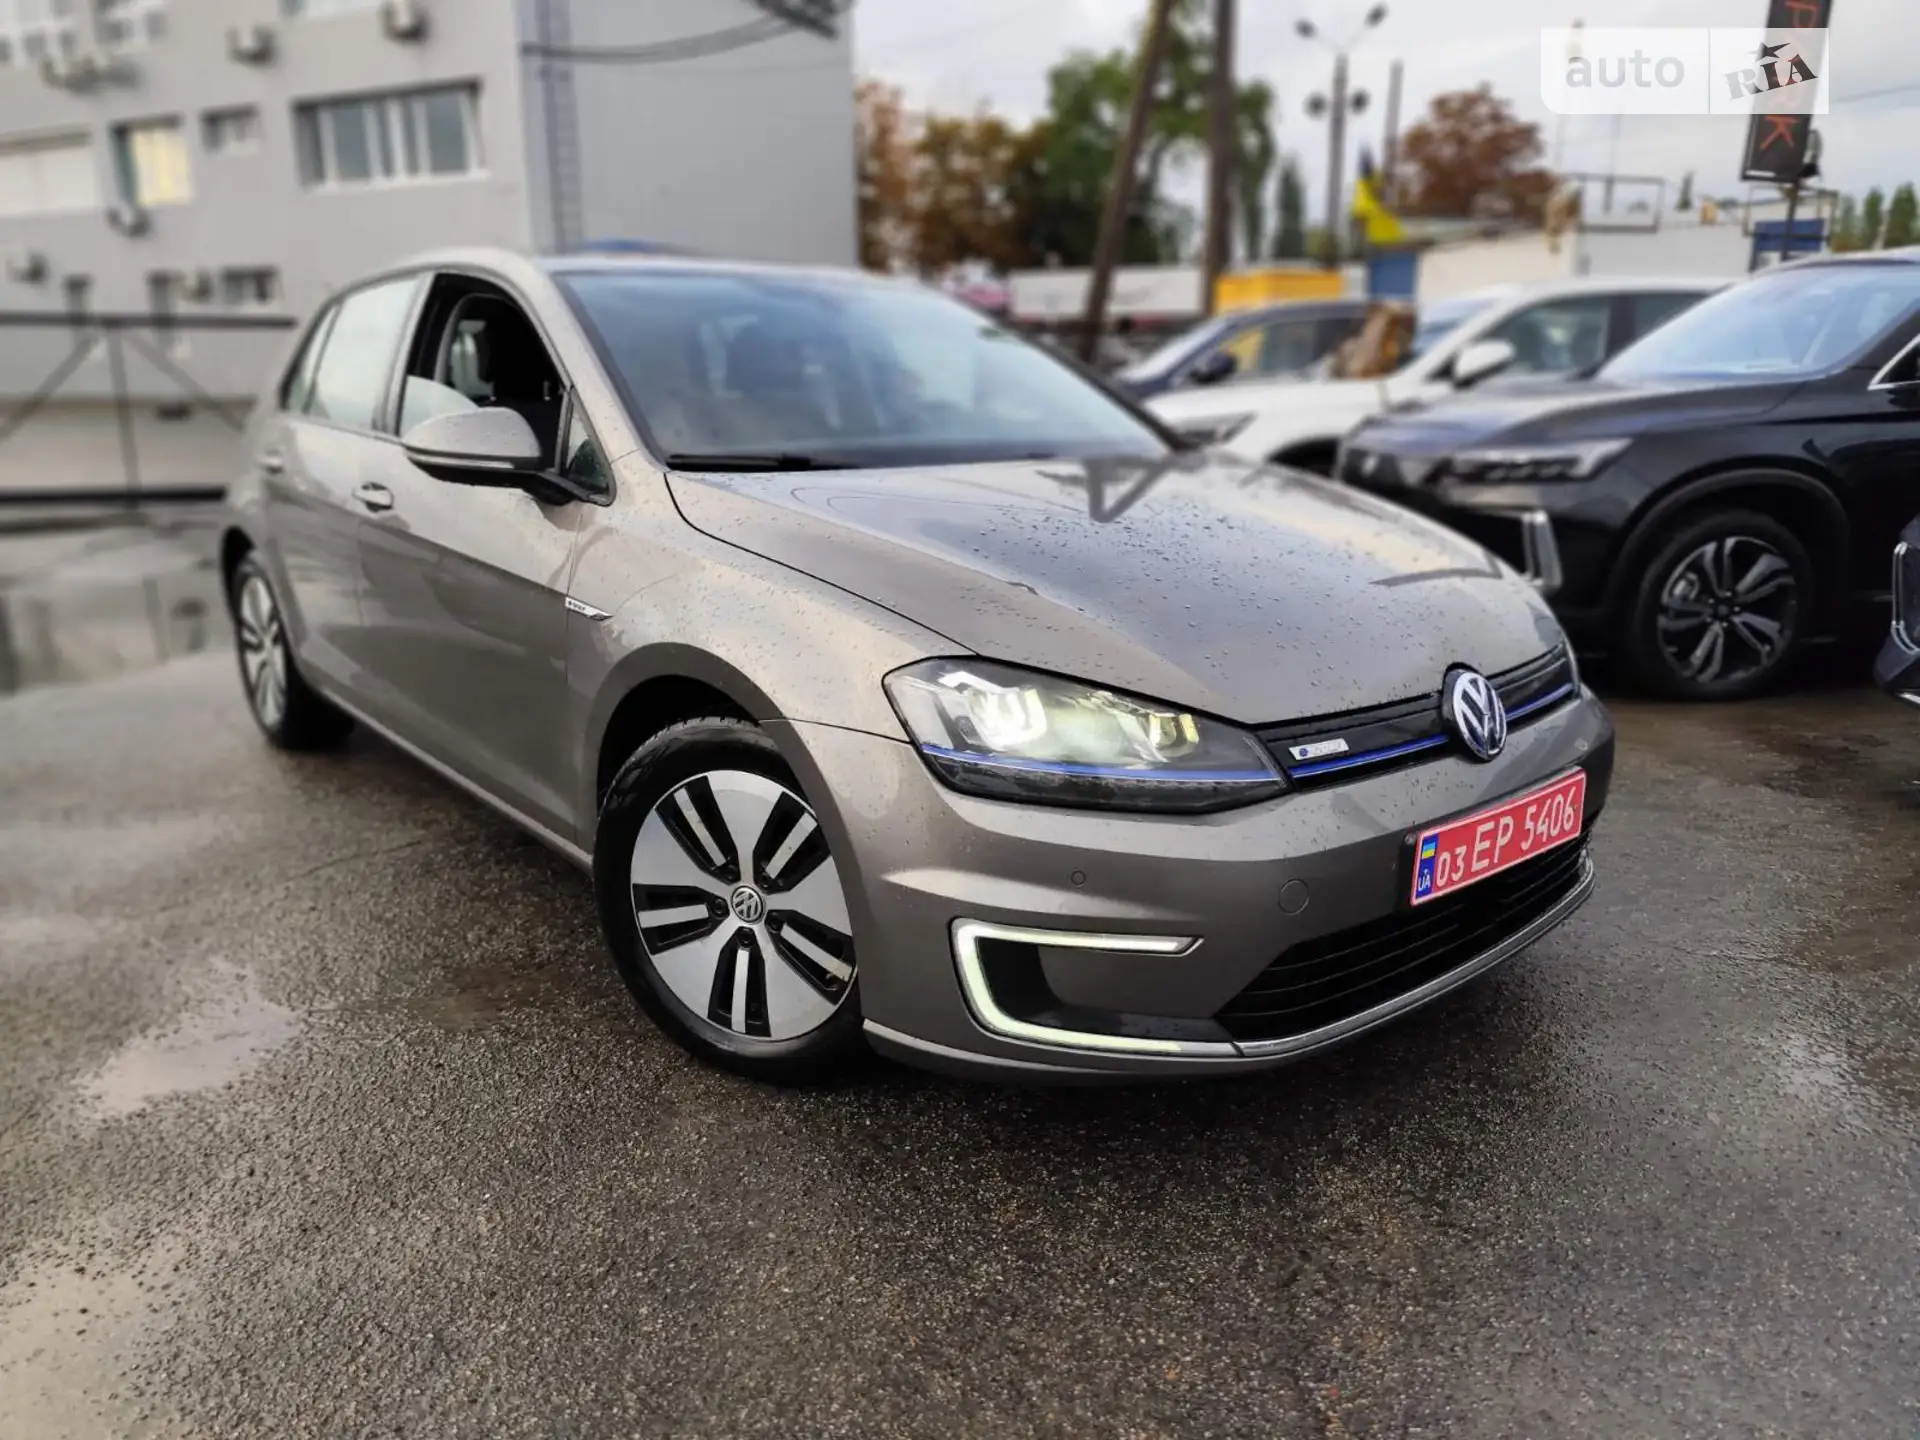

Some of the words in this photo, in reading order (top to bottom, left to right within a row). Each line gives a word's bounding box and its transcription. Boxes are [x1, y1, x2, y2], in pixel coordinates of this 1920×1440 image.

[1436, 845, 1467, 887] 03
[1471, 815, 1514, 872] EP
[1520, 786, 1576, 851] 5406
[1418, 875, 1431, 892] UA
